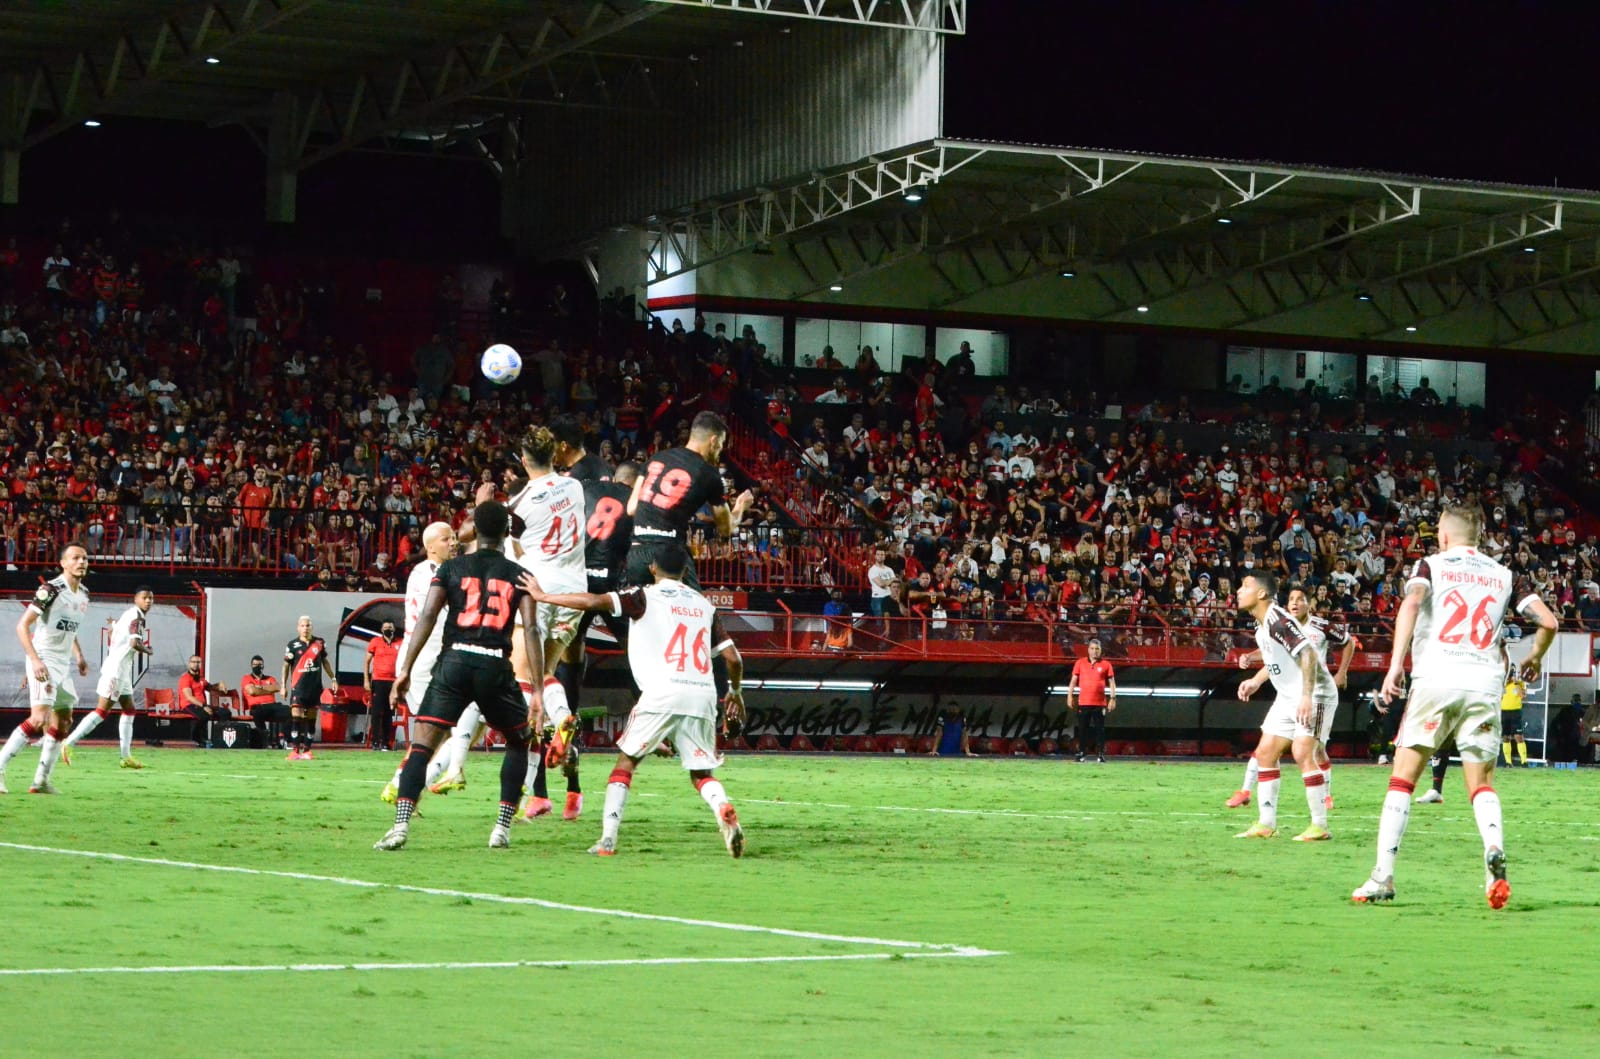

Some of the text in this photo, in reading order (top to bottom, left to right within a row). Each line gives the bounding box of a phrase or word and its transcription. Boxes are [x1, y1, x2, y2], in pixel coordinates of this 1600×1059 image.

[549, 498, 572, 512] NOGA
[638, 461, 692, 510] 19
[541, 512, 579, 555] 41
[586, 496, 625, 540] 8
[1441, 570, 1463, 582] PIRIS
[456, 577, 515, 630] 13
[671, 605, 704, 618] WESLEY
[720, 594, 734, 606] 03
[1438, 589, 1498, 650] 26
[664, 621, 711, 675] 46
[742, 697, 863, 737] DRAGÃO
